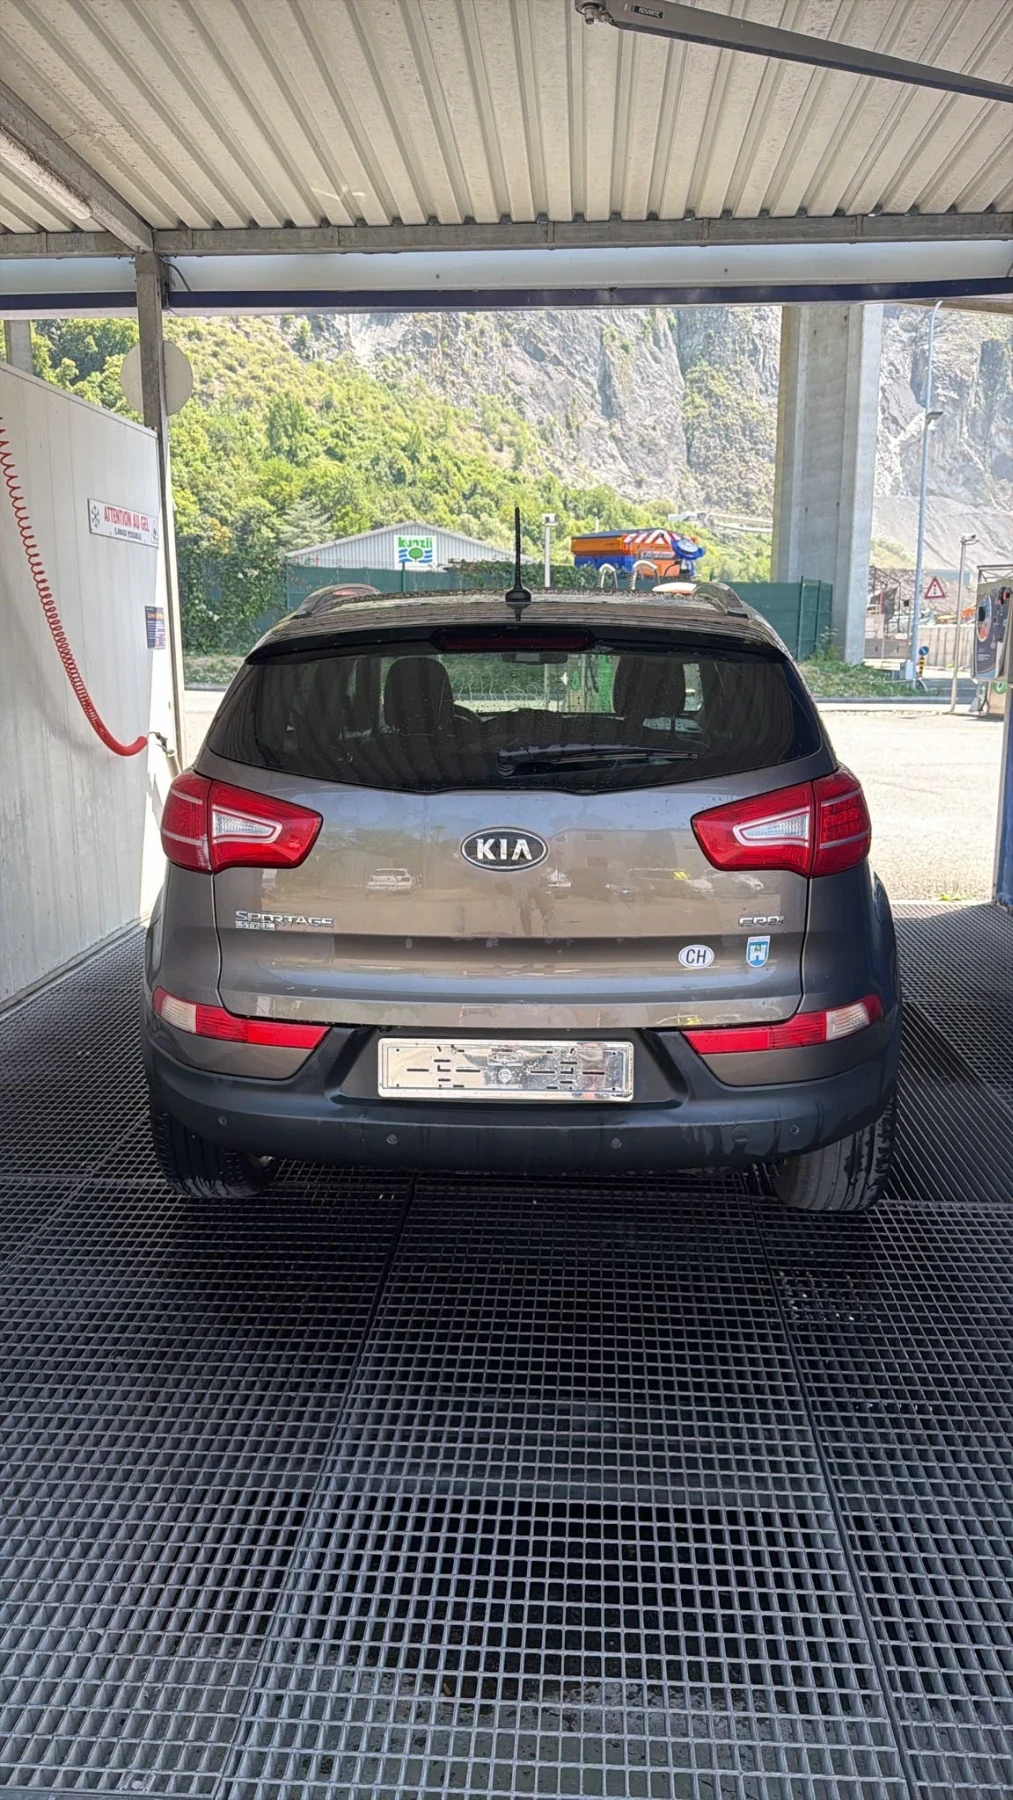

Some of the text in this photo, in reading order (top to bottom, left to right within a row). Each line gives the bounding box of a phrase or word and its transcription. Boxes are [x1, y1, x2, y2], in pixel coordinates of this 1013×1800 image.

[104, 505, 150, 532] ATTENTION AU GEL
[476, 838, 533, 861] KIA
[235, 910, 334, 928] SPORTAGE
[686, 948, 707, 964] CH
